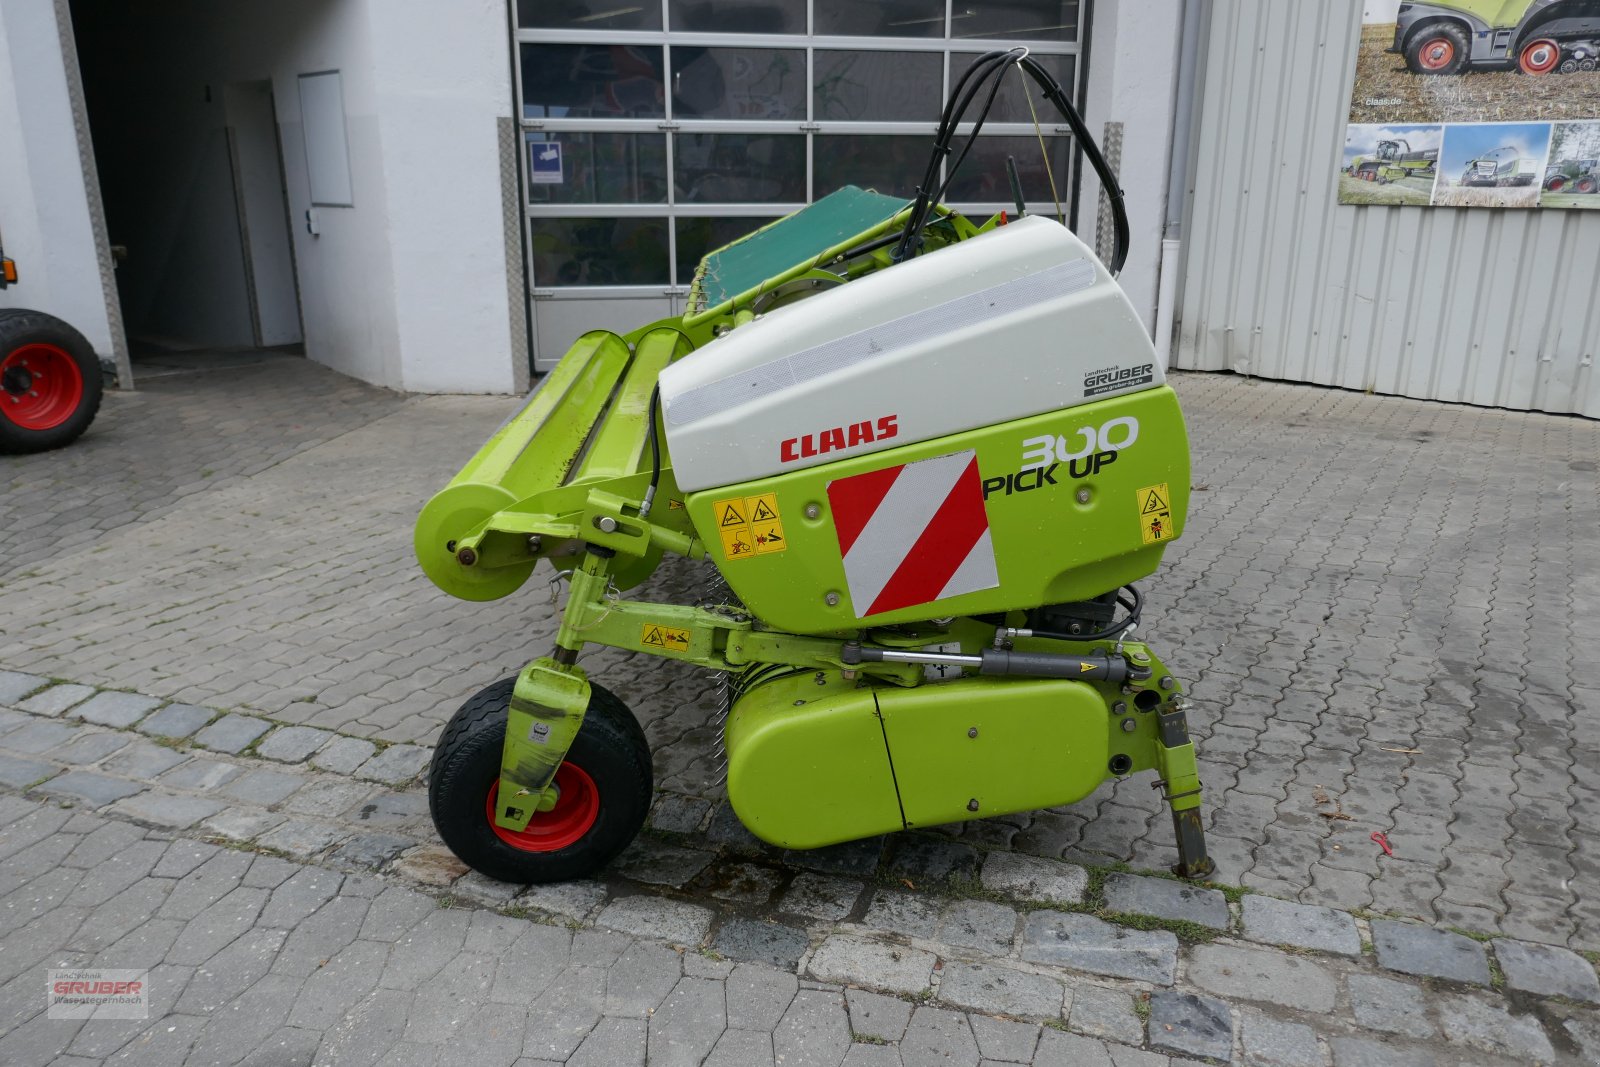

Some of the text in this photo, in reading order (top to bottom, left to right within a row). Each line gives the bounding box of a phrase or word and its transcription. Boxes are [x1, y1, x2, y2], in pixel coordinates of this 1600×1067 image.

[1084, 365, 1119, 377] Landtechnik
[1084, 363, 1153, 387] GRUBER
[1093, 378, 1143, 393] www.gruber-kg.de
[780, 414, 898, 463] CLAAS
[1021, 416, 1139, 472] 300
[983, 450, 1118, 501] PICK UP
